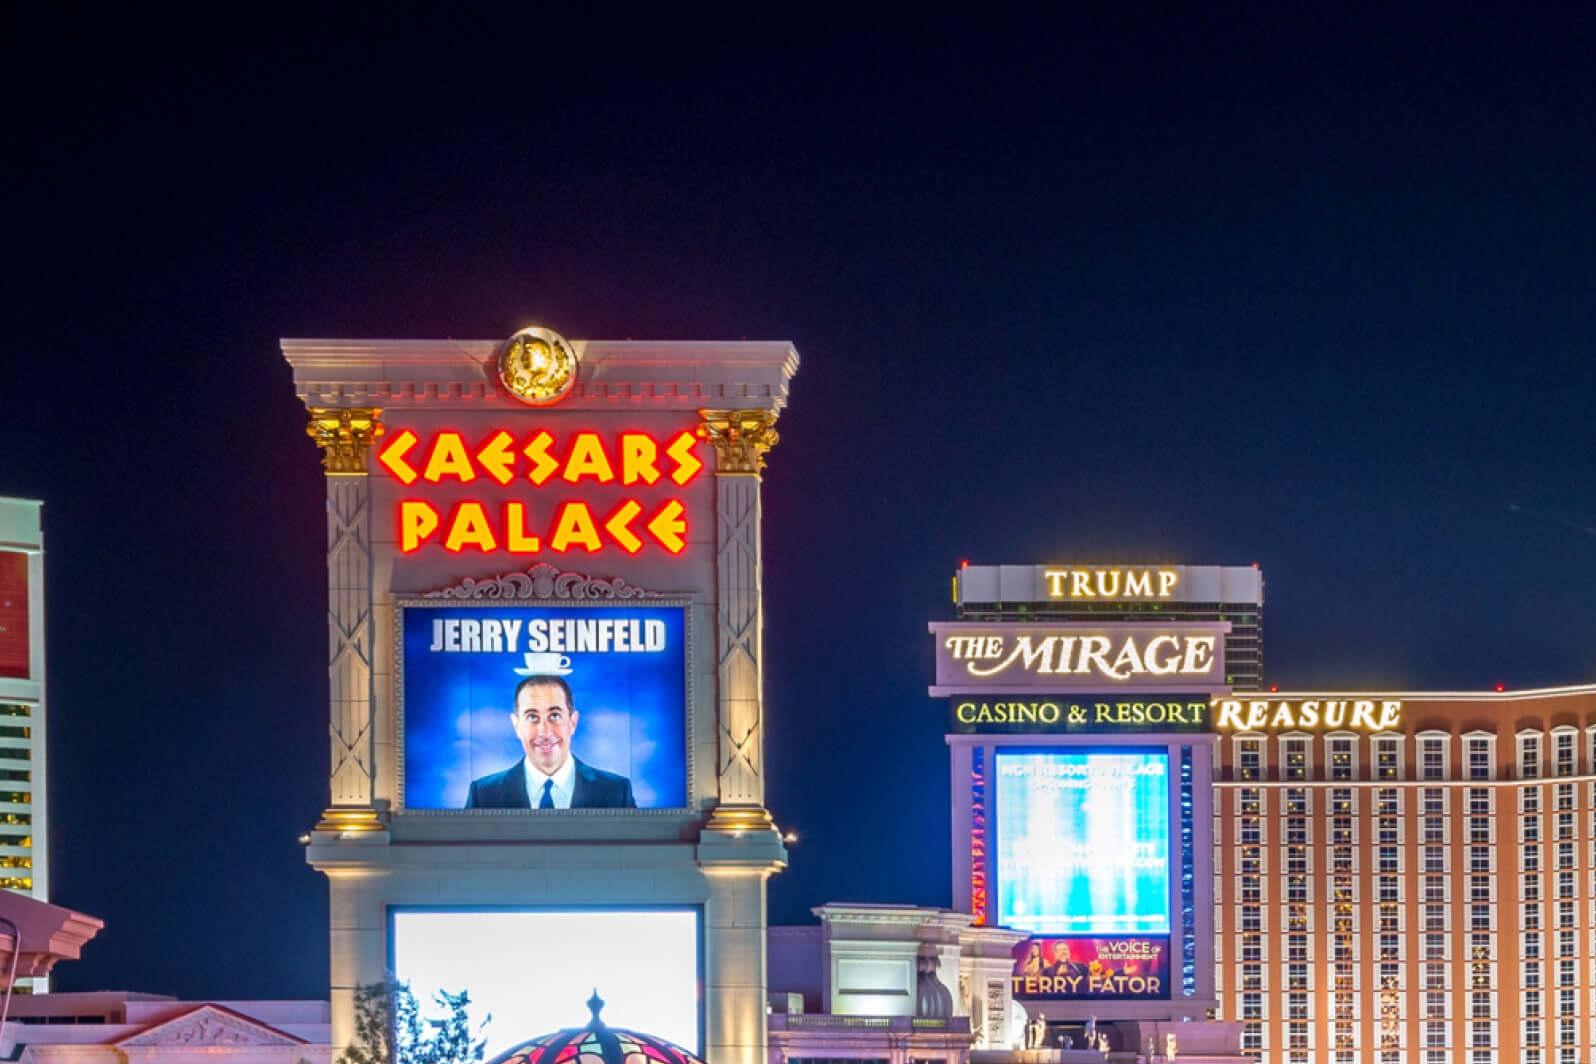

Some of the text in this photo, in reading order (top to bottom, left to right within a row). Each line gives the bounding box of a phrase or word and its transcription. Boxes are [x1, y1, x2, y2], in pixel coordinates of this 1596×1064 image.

[379, 431, 702, 487] CAESARS
[401, 500, 688, 553] PALACE
[1045, 571, 1177, 597] TRUMP
[431, 619, 666, 653] JERRY SEINFELD
[946, 636, 1214, 680] THE MIRAGE
[957, 703, 1206, 723] CASINO & RESORT
[1211, 699, 1401, 731] REASURE
[1109, 942, 1150, 953] VOICE
[1012, 976, 1160, 993] TERRY FATOR
